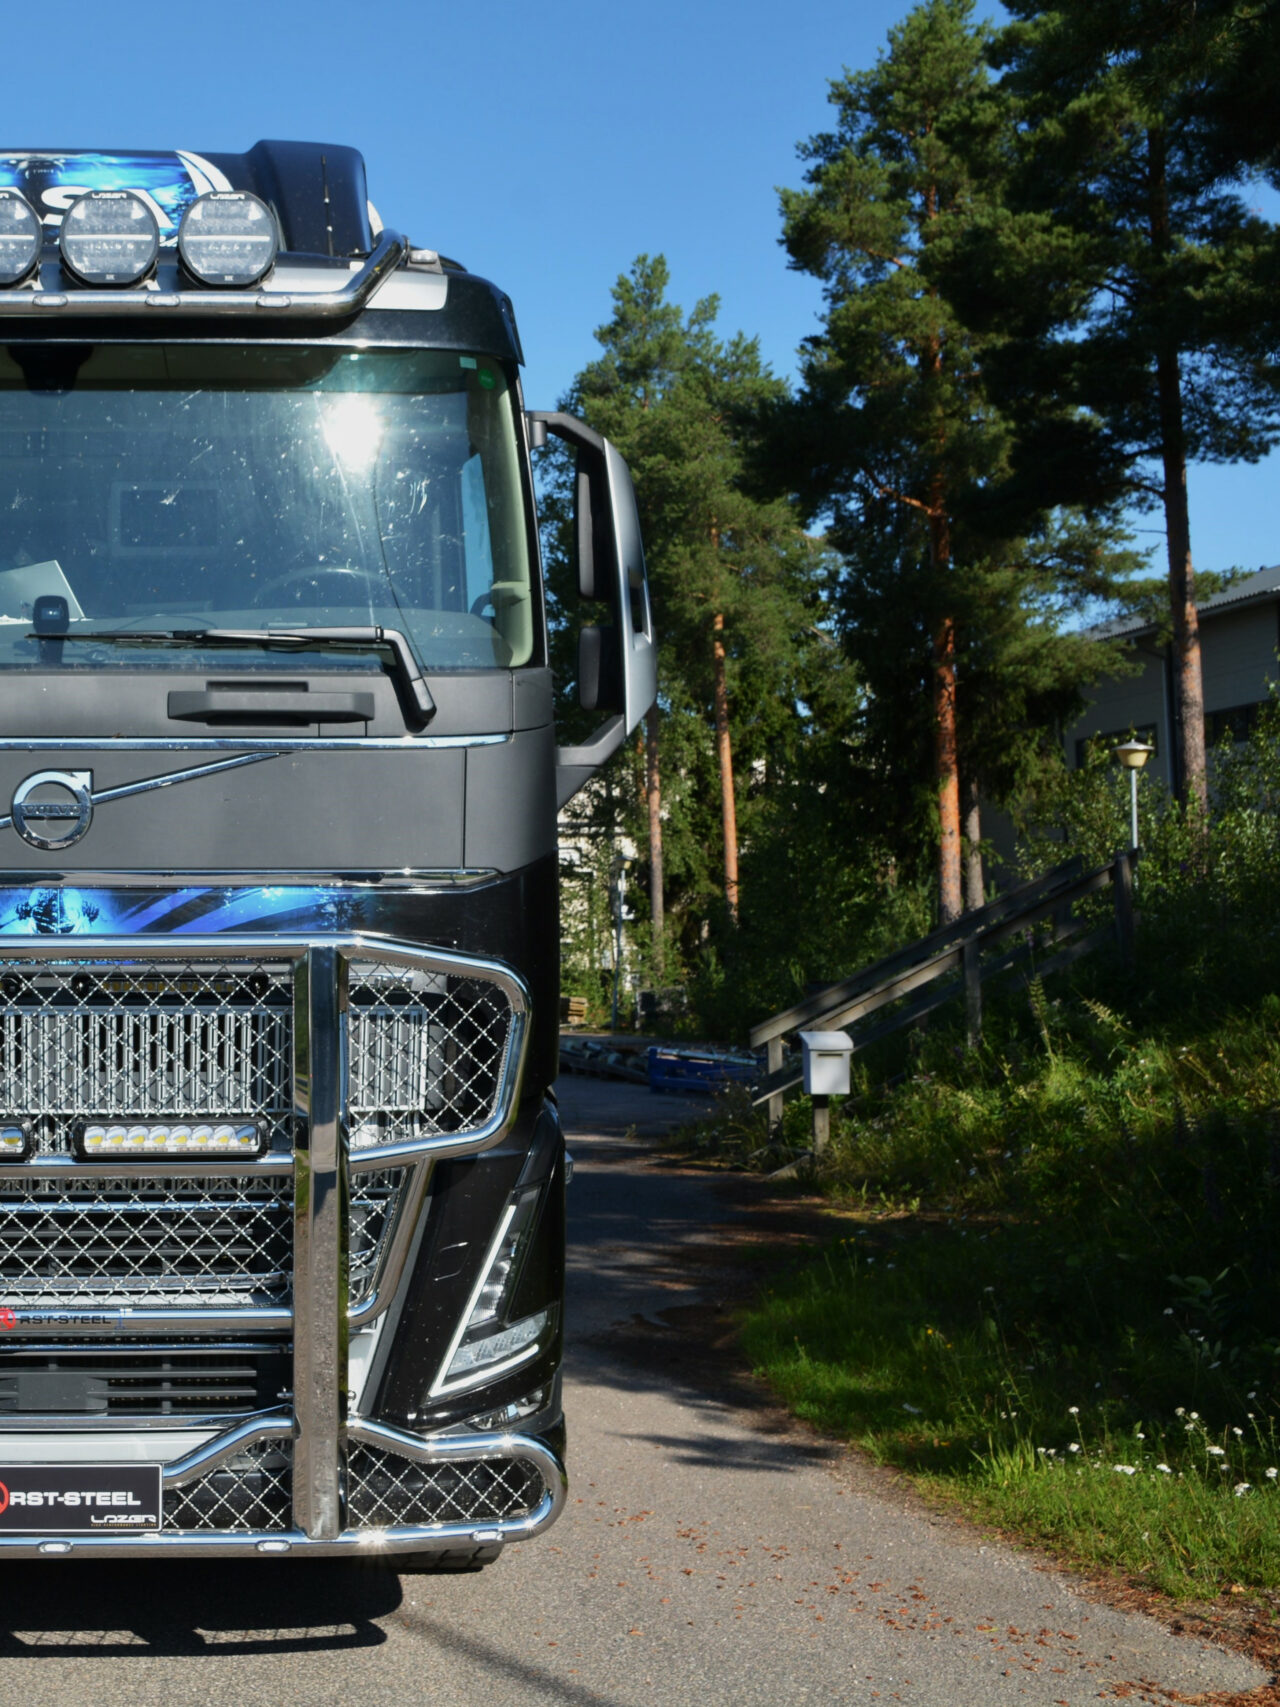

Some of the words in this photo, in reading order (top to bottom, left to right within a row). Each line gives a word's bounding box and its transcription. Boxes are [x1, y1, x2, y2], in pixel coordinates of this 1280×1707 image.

[20, 1315, 112, 1325] RST-STEEL
[9, 1491, 141, 1506] RST-STEEL
[90, 1514, 157, 1524] LAZER
